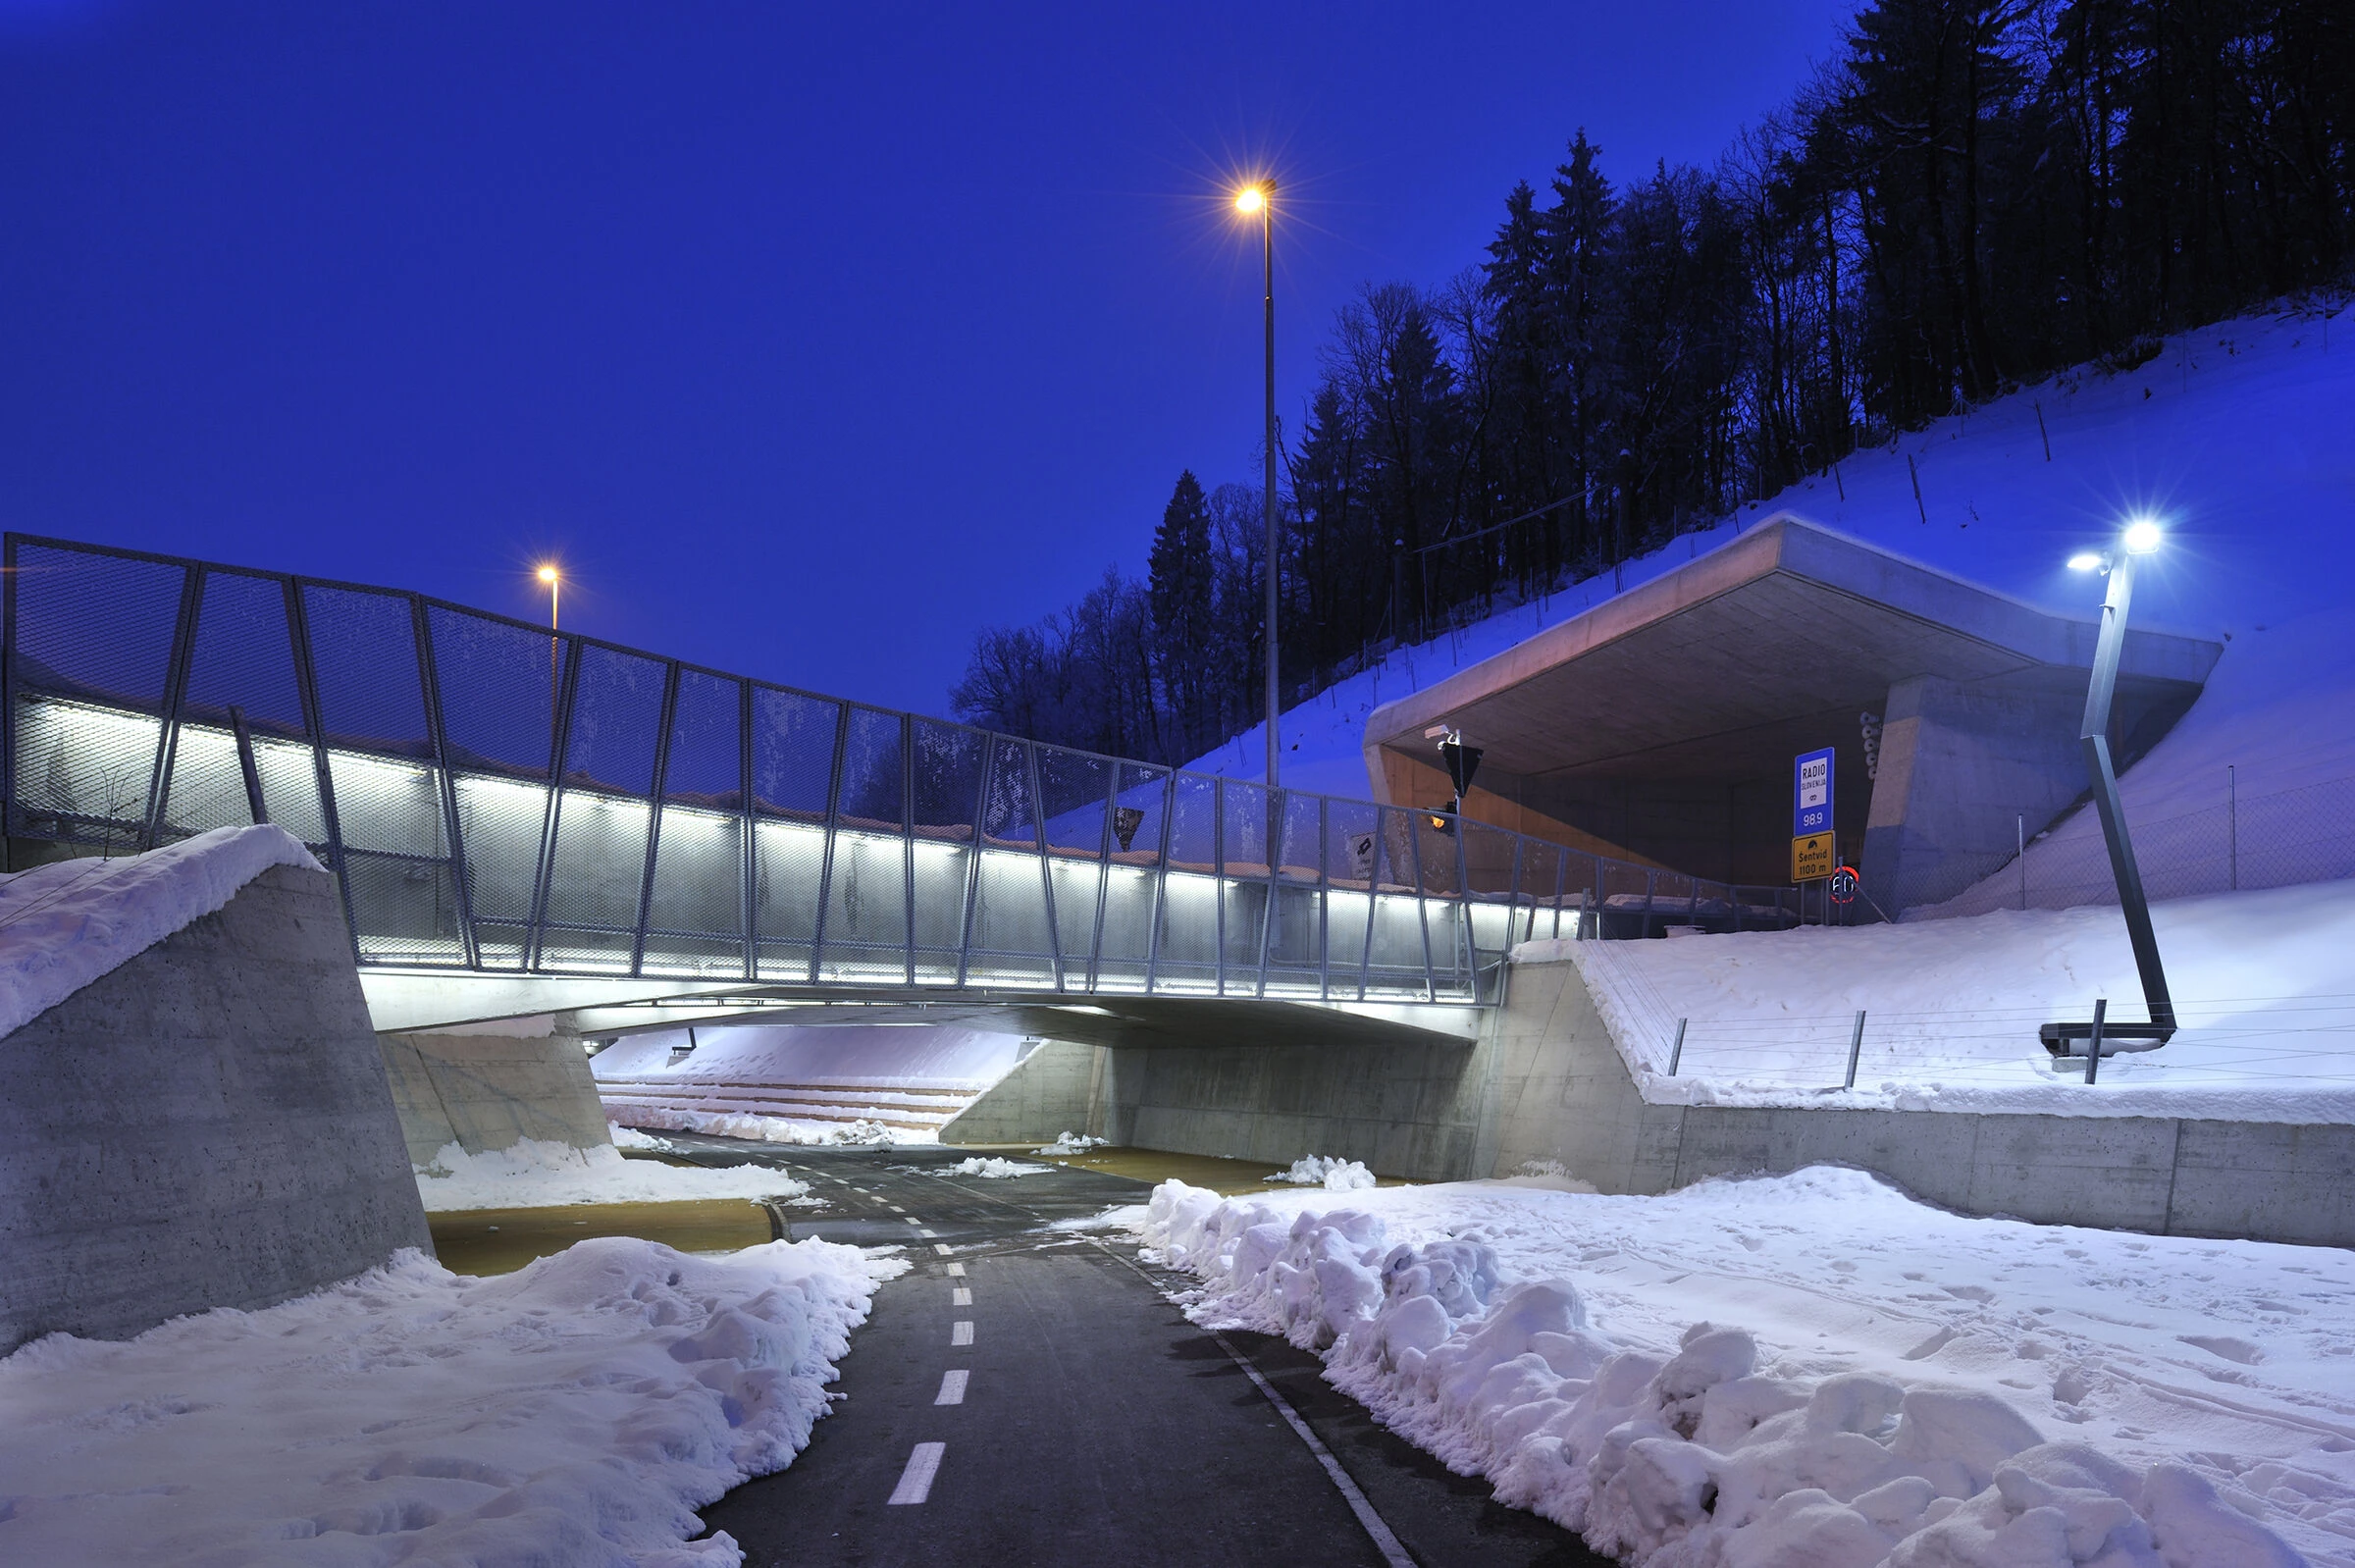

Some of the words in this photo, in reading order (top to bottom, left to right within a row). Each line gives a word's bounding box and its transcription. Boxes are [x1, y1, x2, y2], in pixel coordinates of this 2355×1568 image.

[1803, 763, 1826, 779] RADIO
[1802, 779, 1826, 790] SLOVENIJA
[1799, 849, 1827, 862] Šentvid
[1800, 863, 1815, 875] 1100
